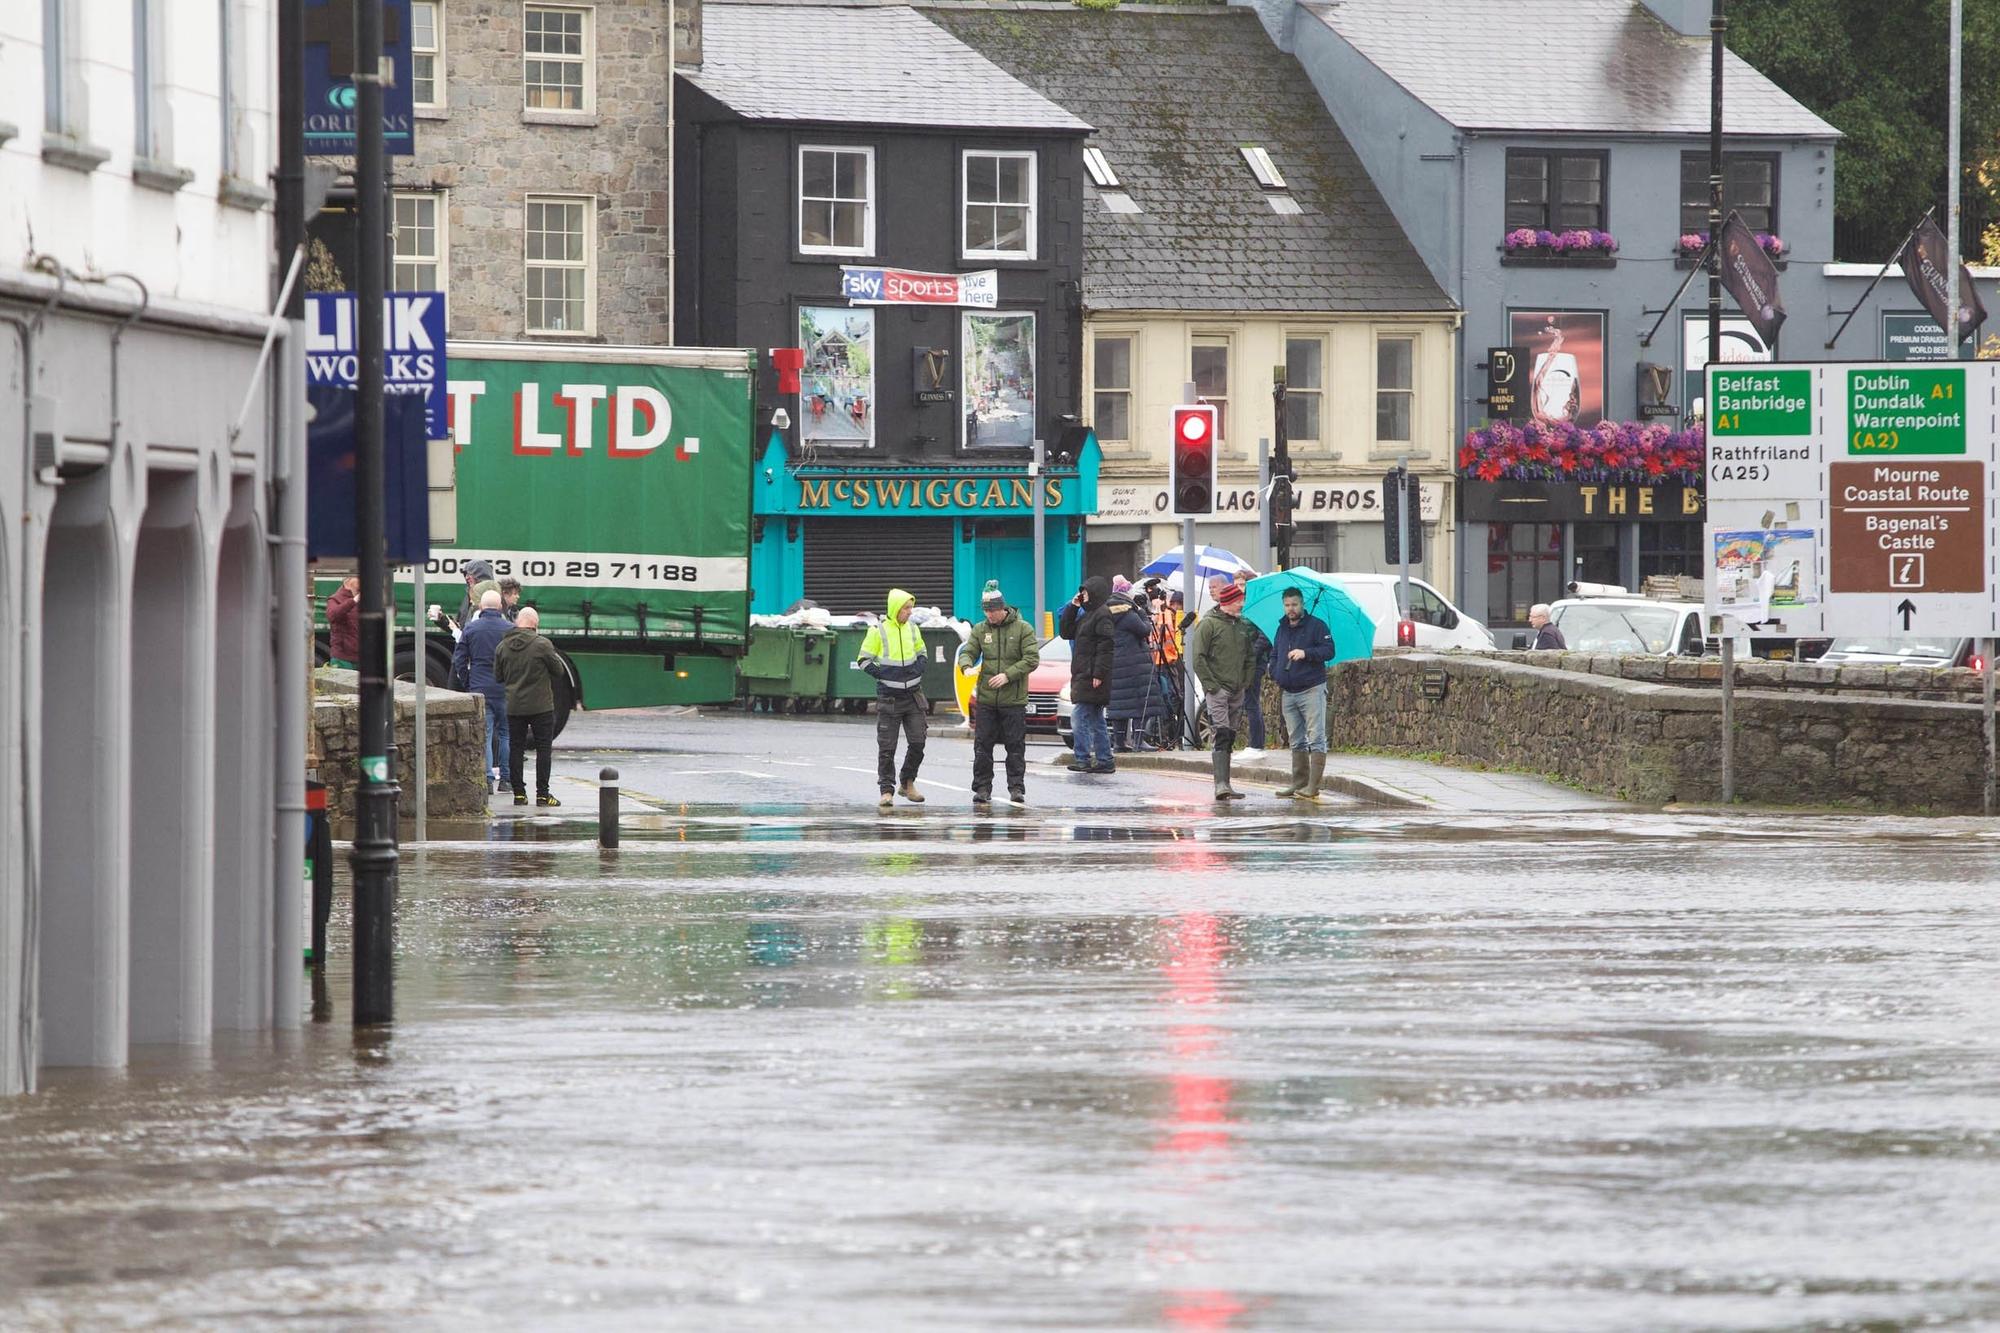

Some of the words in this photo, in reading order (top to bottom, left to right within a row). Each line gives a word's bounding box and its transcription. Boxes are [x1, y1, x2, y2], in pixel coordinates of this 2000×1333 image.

[849, 272, 881, 299] sky
[888, 278, 954, 298] sports
[964, 275, 986, 288] live
[964, 290, 994, 303] here
[304, 298, 435, 350] LIK
[1908, 346, 1933, 354] WORLD
[305, 354, 435, 381] WOKS
[1719, 376, 1781, 392] Belfast
[1854, 375, 1910, 391] Dublin
[1931, 383, 1953, 399] A1
[1490, 395, 1515, 403] BRIDGE
[1719, 395, 1806, 413] Banbridge
[1854, 394, 1926, 409] Dundalk
[514, 382, 700, 458] LTD.
[1718, 413, 1740, 429] A1
[1853, 412, 1961, 430] Warrenpoint
[1852, 431, 1899, 450] (A2)
[1712, 445, 1809, 460] Rathfriland
[1711, 464, 1769, 482] (A25)
[1874, 467, 1940, 482] Mourne
[1312, 489, 1380, 511] BROS.
[1580, 486, 1654, 514] THE
[1844, 485, 1911, 501] Coastal
[1917, 485, 1970, 501] Route
[1865, 514, 1949, 533] Bagenal's
[1878, 533, 1936, 549] Castle
[522, 560, 556, 578] (0)
[566, 561, 600, 577] 29
[610, 562, 697, 582] 71188
